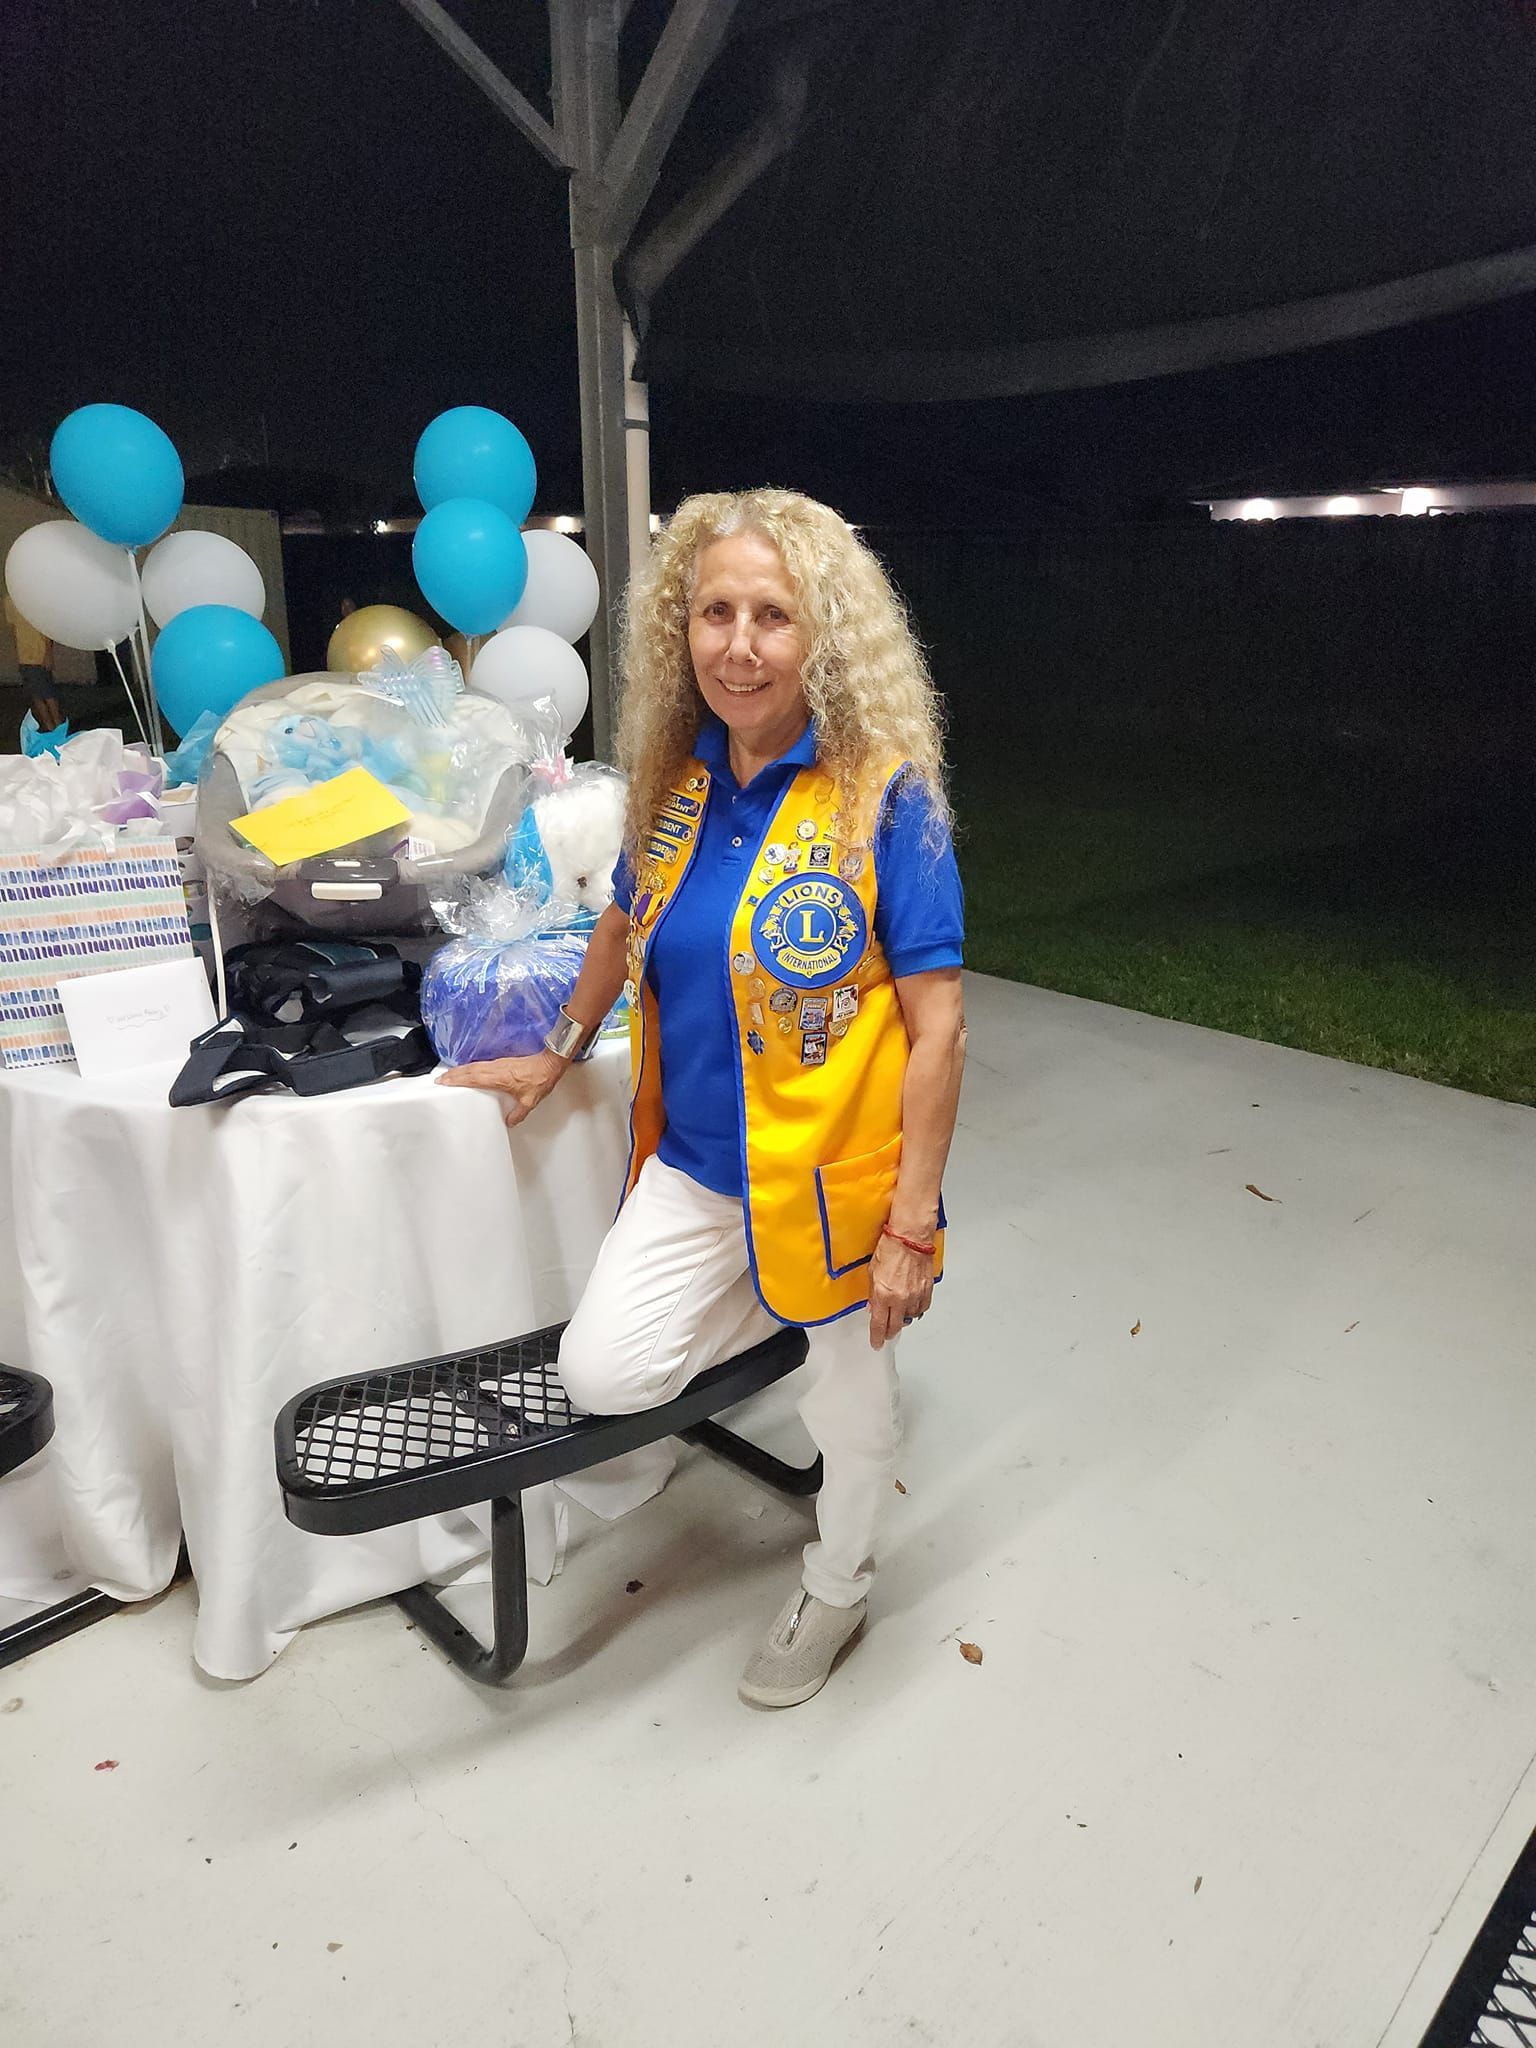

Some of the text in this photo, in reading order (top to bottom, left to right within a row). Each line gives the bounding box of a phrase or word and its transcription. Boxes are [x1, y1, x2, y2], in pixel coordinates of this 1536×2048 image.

[782, 885, 840, 905] LIONS
[799, 910, 825, 943] L
[782, 952, 838, 970] INTERNATIONAL
